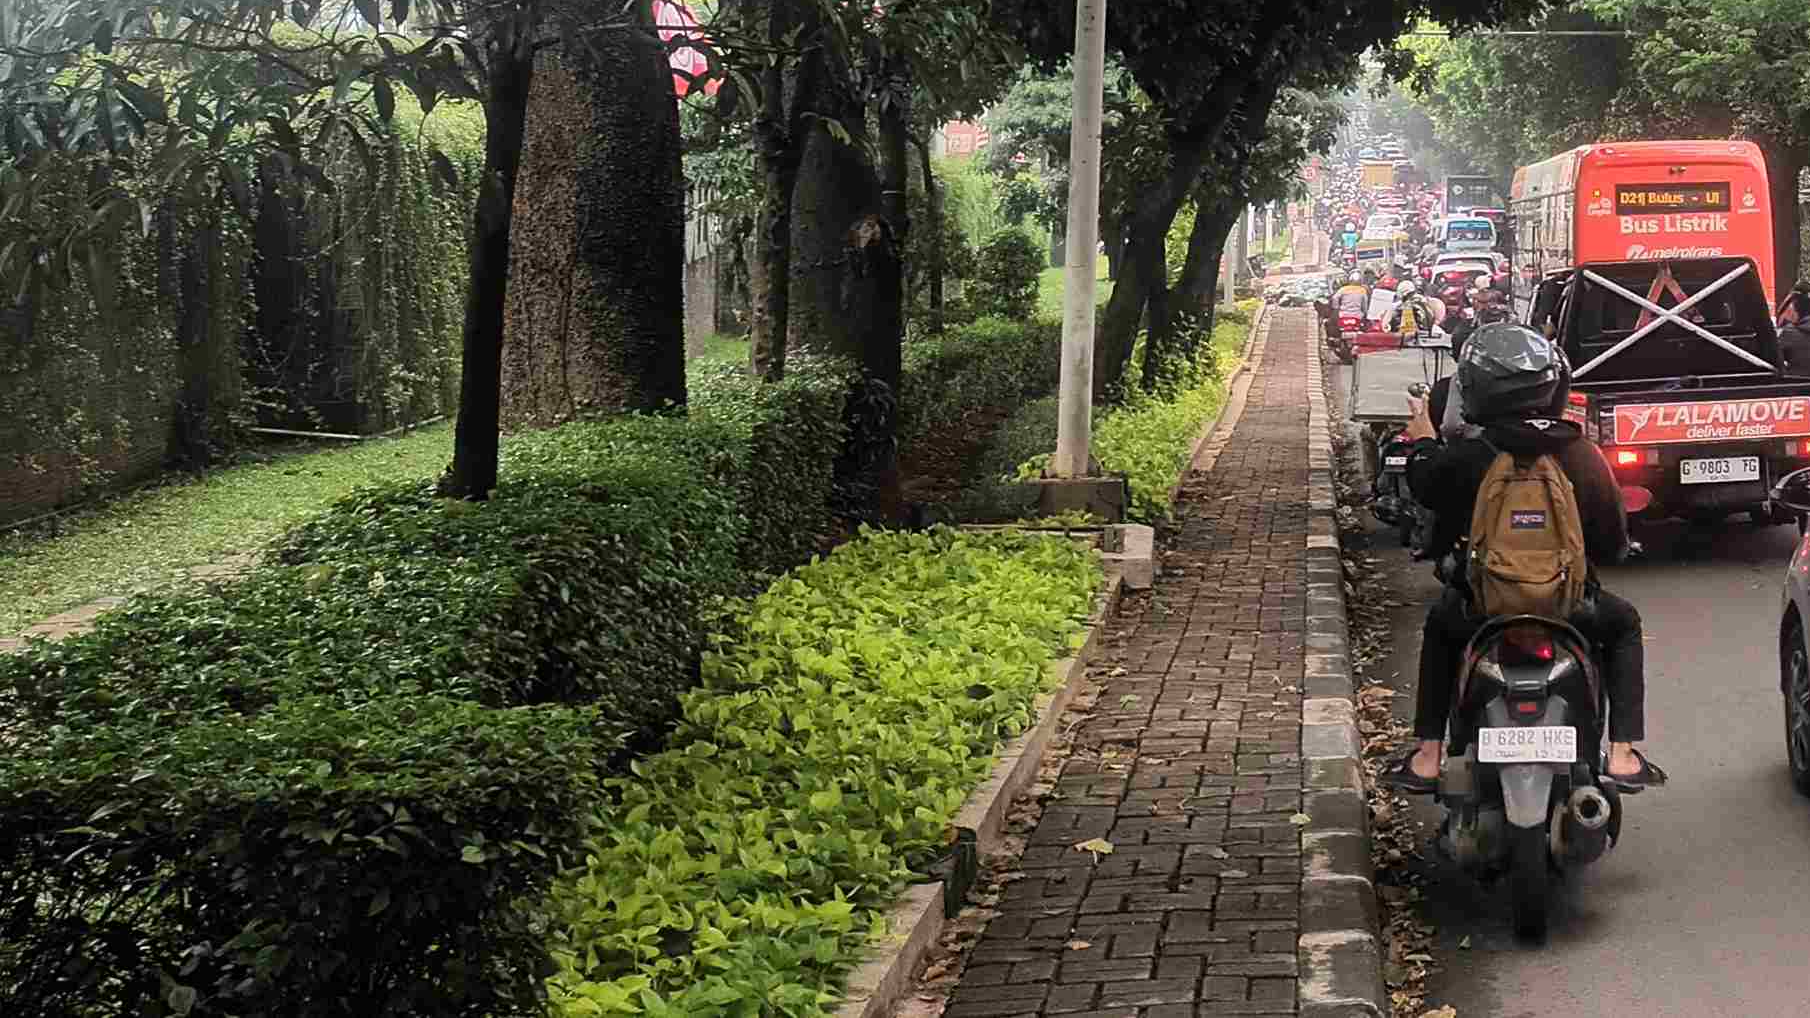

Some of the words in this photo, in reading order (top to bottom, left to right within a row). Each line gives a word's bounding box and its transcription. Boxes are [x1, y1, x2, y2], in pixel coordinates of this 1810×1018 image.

[1620, 215, 1659, 233] Bus
[1664, 212, 1729, 232] Listrik
[1656, 399, 1807, 427] LALAMOVE
[1686, 425, 1734, 439] deliver
[1735, 423, 1775, 436] faster
[1682, 461, 1691, 475] G
[1700, 460, 1731, 474] 9803
